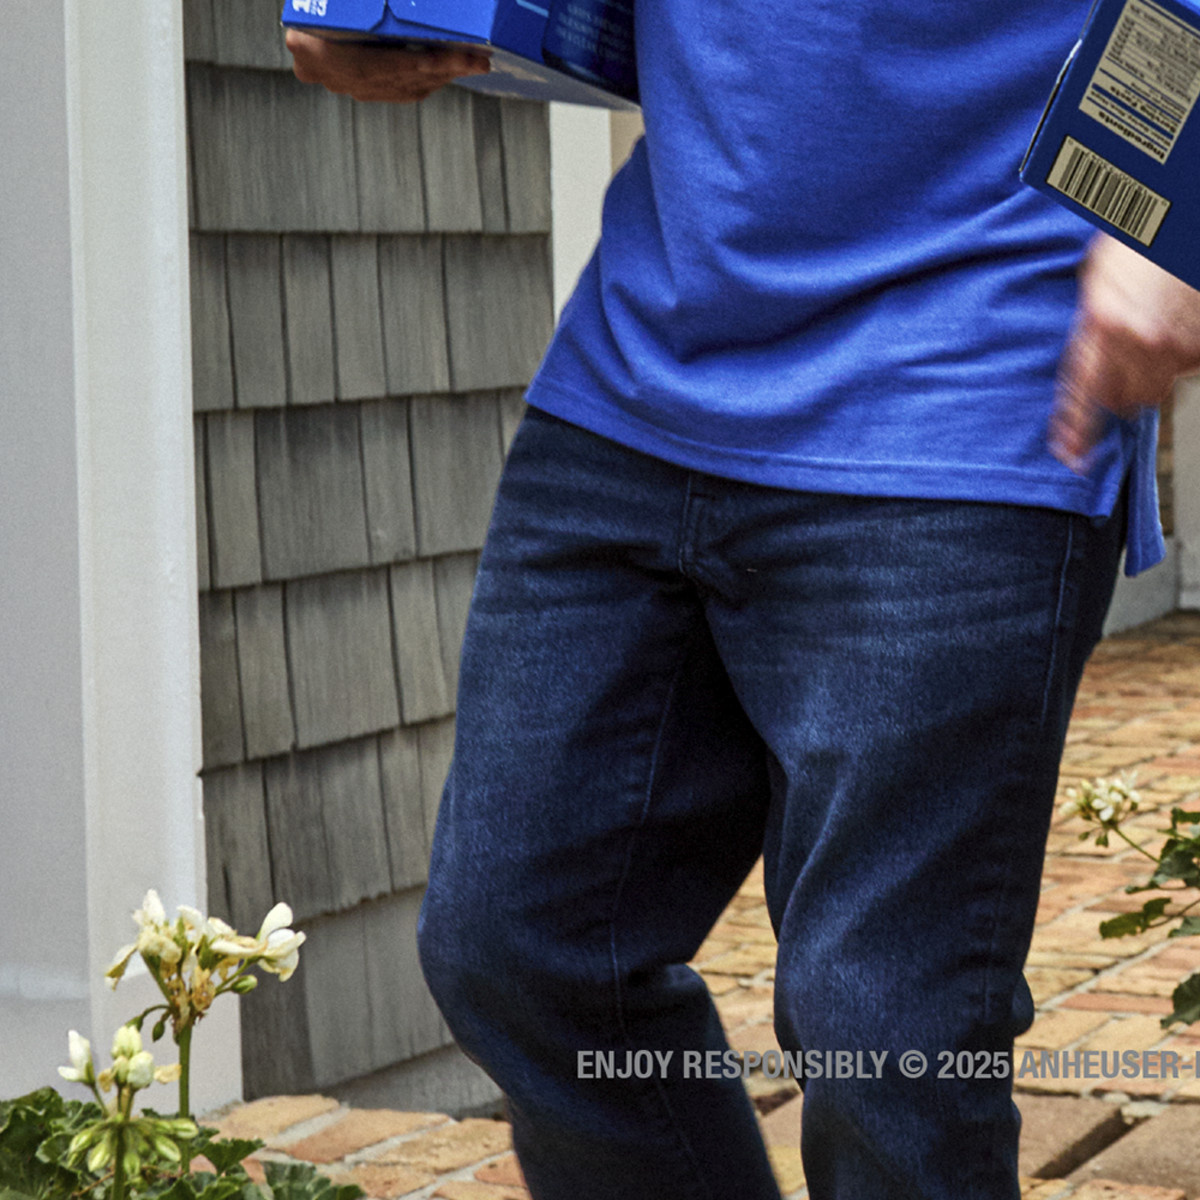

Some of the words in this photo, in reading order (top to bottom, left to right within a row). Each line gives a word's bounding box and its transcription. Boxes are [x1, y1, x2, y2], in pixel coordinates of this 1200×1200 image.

[1108, 85, 1138, 108] Facts
[1096, 109, 1166, 159] Ingredients
[1138, 104, 1177, 134] Serving
